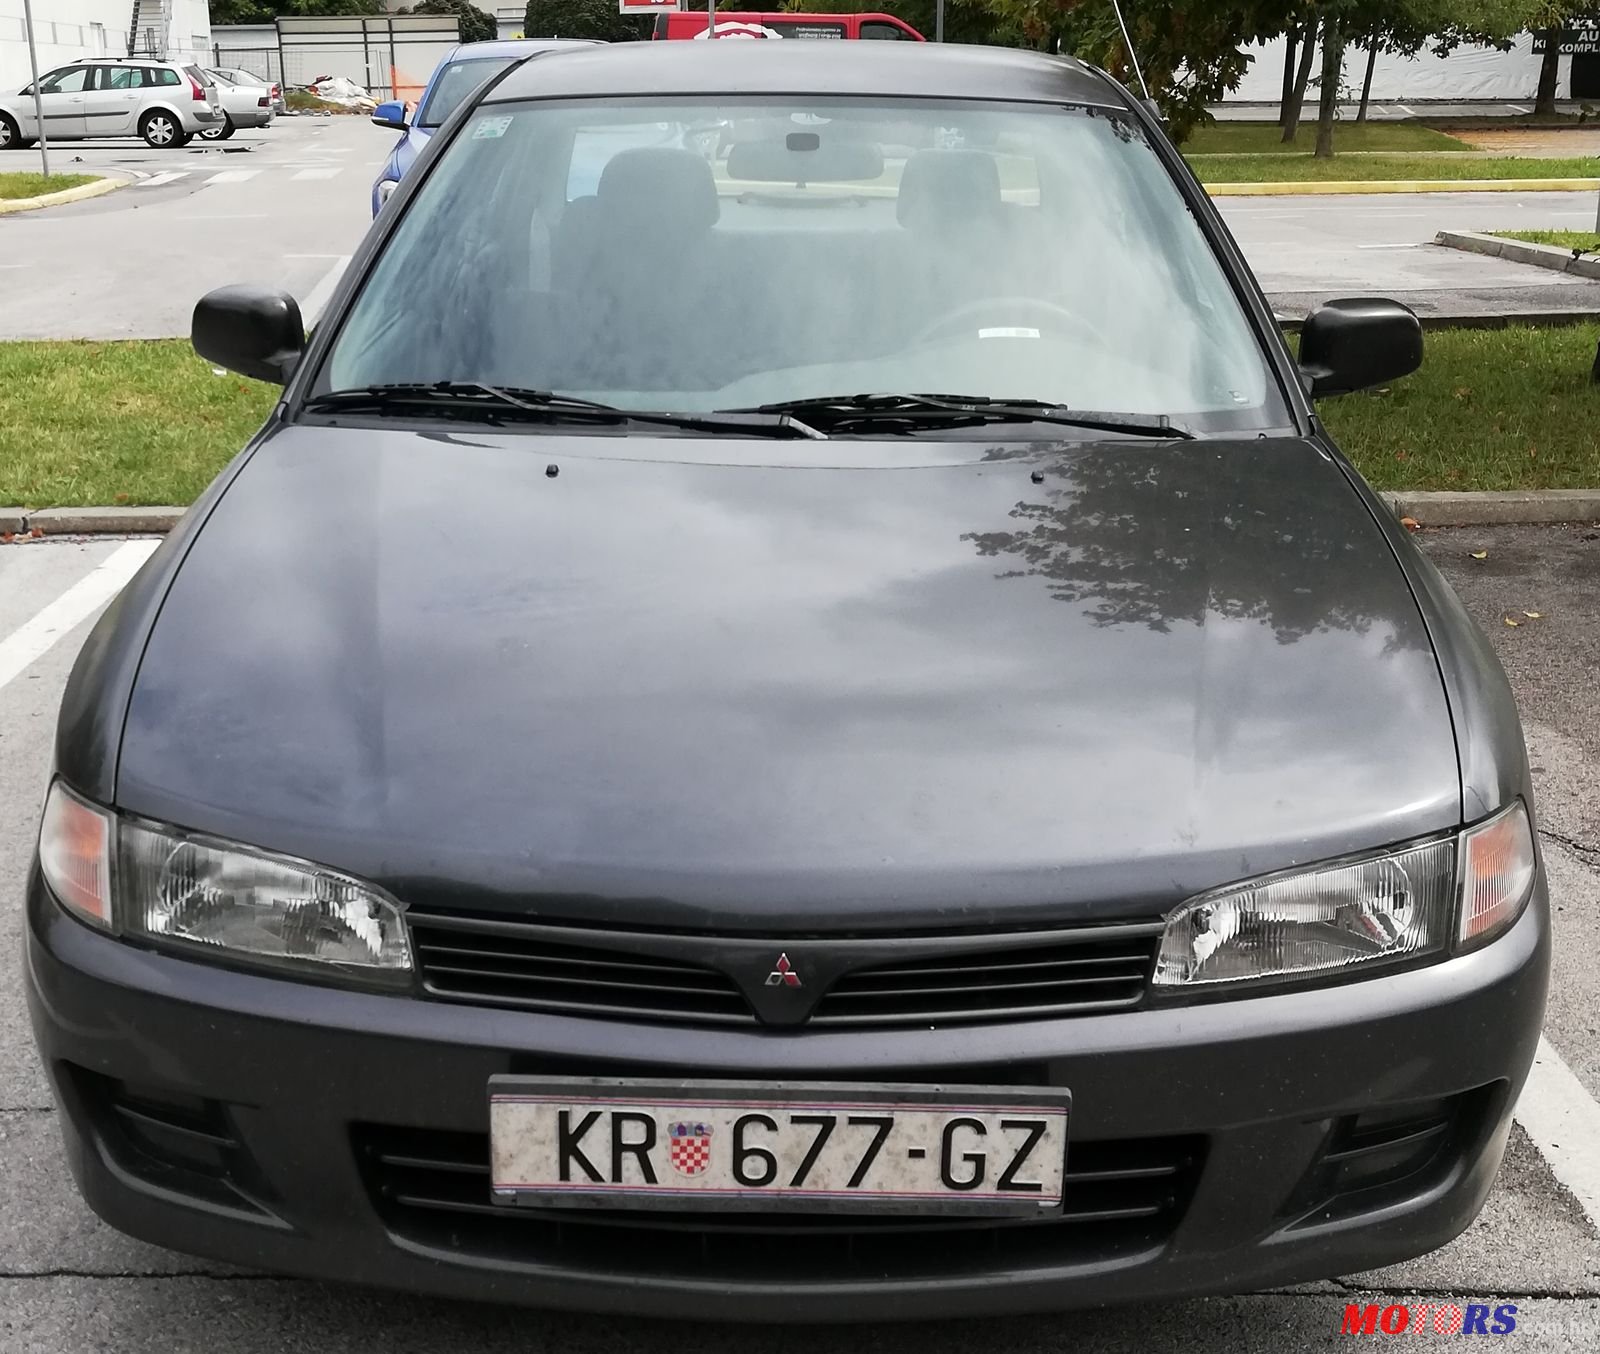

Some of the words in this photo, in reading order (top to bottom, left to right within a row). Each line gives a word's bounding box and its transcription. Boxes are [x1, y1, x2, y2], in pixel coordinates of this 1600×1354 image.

[1558, 43, 1600, 53] KOMPL
[556, 1109, 658, 1185] KR
[731, 1113, 1048, 1192] 677-GZ
